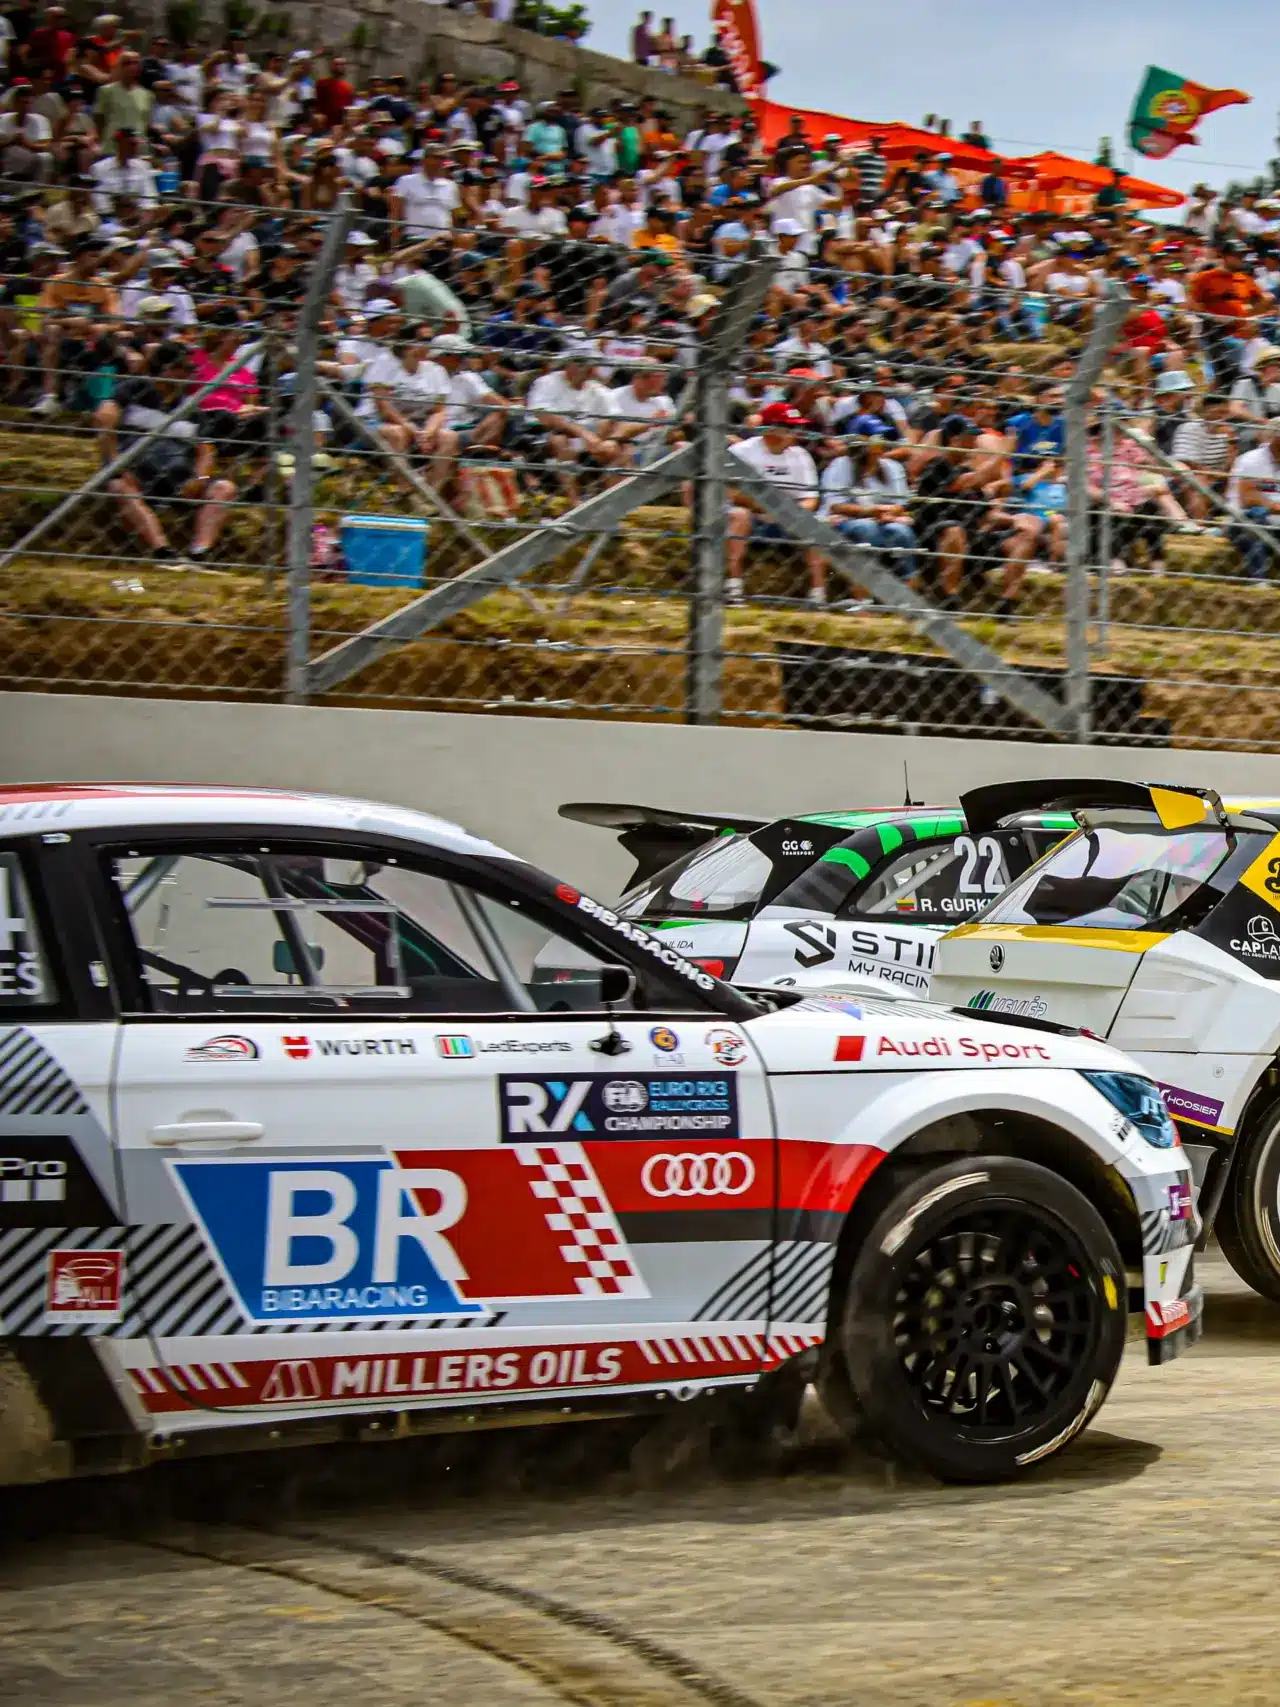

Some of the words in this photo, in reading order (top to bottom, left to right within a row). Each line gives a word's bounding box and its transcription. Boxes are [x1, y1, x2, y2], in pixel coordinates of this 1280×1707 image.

[782, 840, 798, 850] GG
[954, 835, 1006, 893] 22
[920, 898, 937, 912] R.
[940, 898, 992, 912] GURK
[577, 896, 716, 989] BIBARACING
[848, 960, 874, 976] MY
[476, 1039, 574, 1055] LedExperts
[876, 1035, 950, 1057] Audi
[960, 1037, 1051, 1062] Sport
[650, 1080, 695, 1097] EURO
[697, 1080, 729, 1097] RX3
[506, 1080, 596, 1133] RX
[1167, 1095, 1218, 1117] HOOSIER
[604, 1115, 732, 1132] CHAMPIONSHIP
[263, 1168, 471, 1287] BR
[261, 1285, 429, 1312] BIBARACING
[331, 1352, 521, 1396] MILLERS
[528, 1347, 623, 1385] OILS
